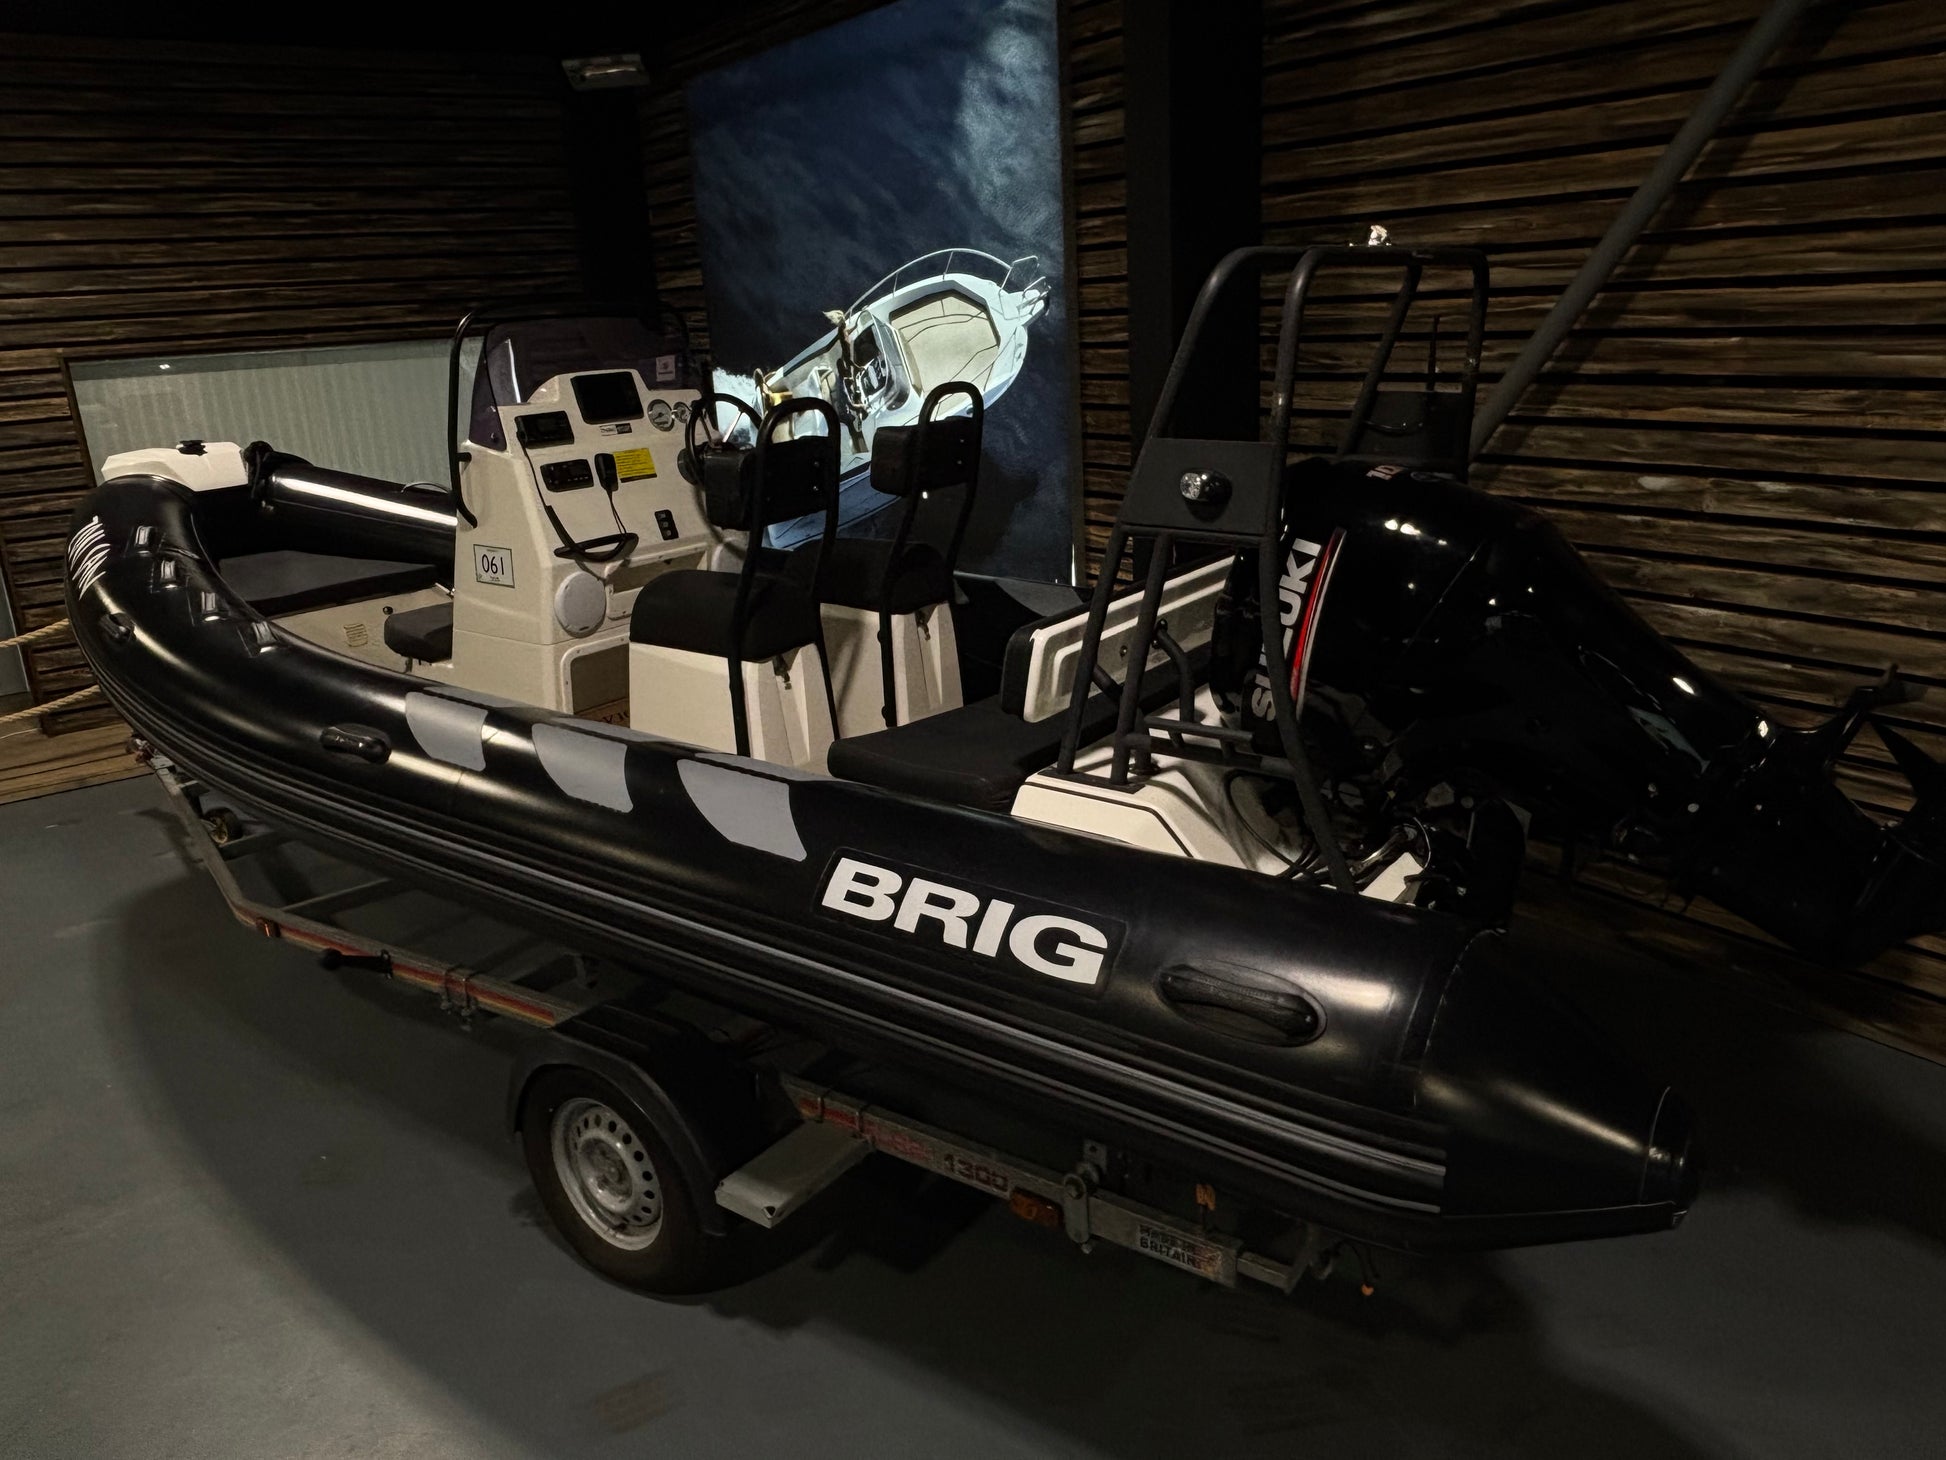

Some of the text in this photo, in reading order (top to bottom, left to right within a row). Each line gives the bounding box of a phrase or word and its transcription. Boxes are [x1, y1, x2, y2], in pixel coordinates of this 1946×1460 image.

[482, 554, 504, 576] 061
[1252, 538, 1321, 721] SUKI
[821, 857, 1108, 984] BRIG
[943, 1154, 1008, 1192] 1300
